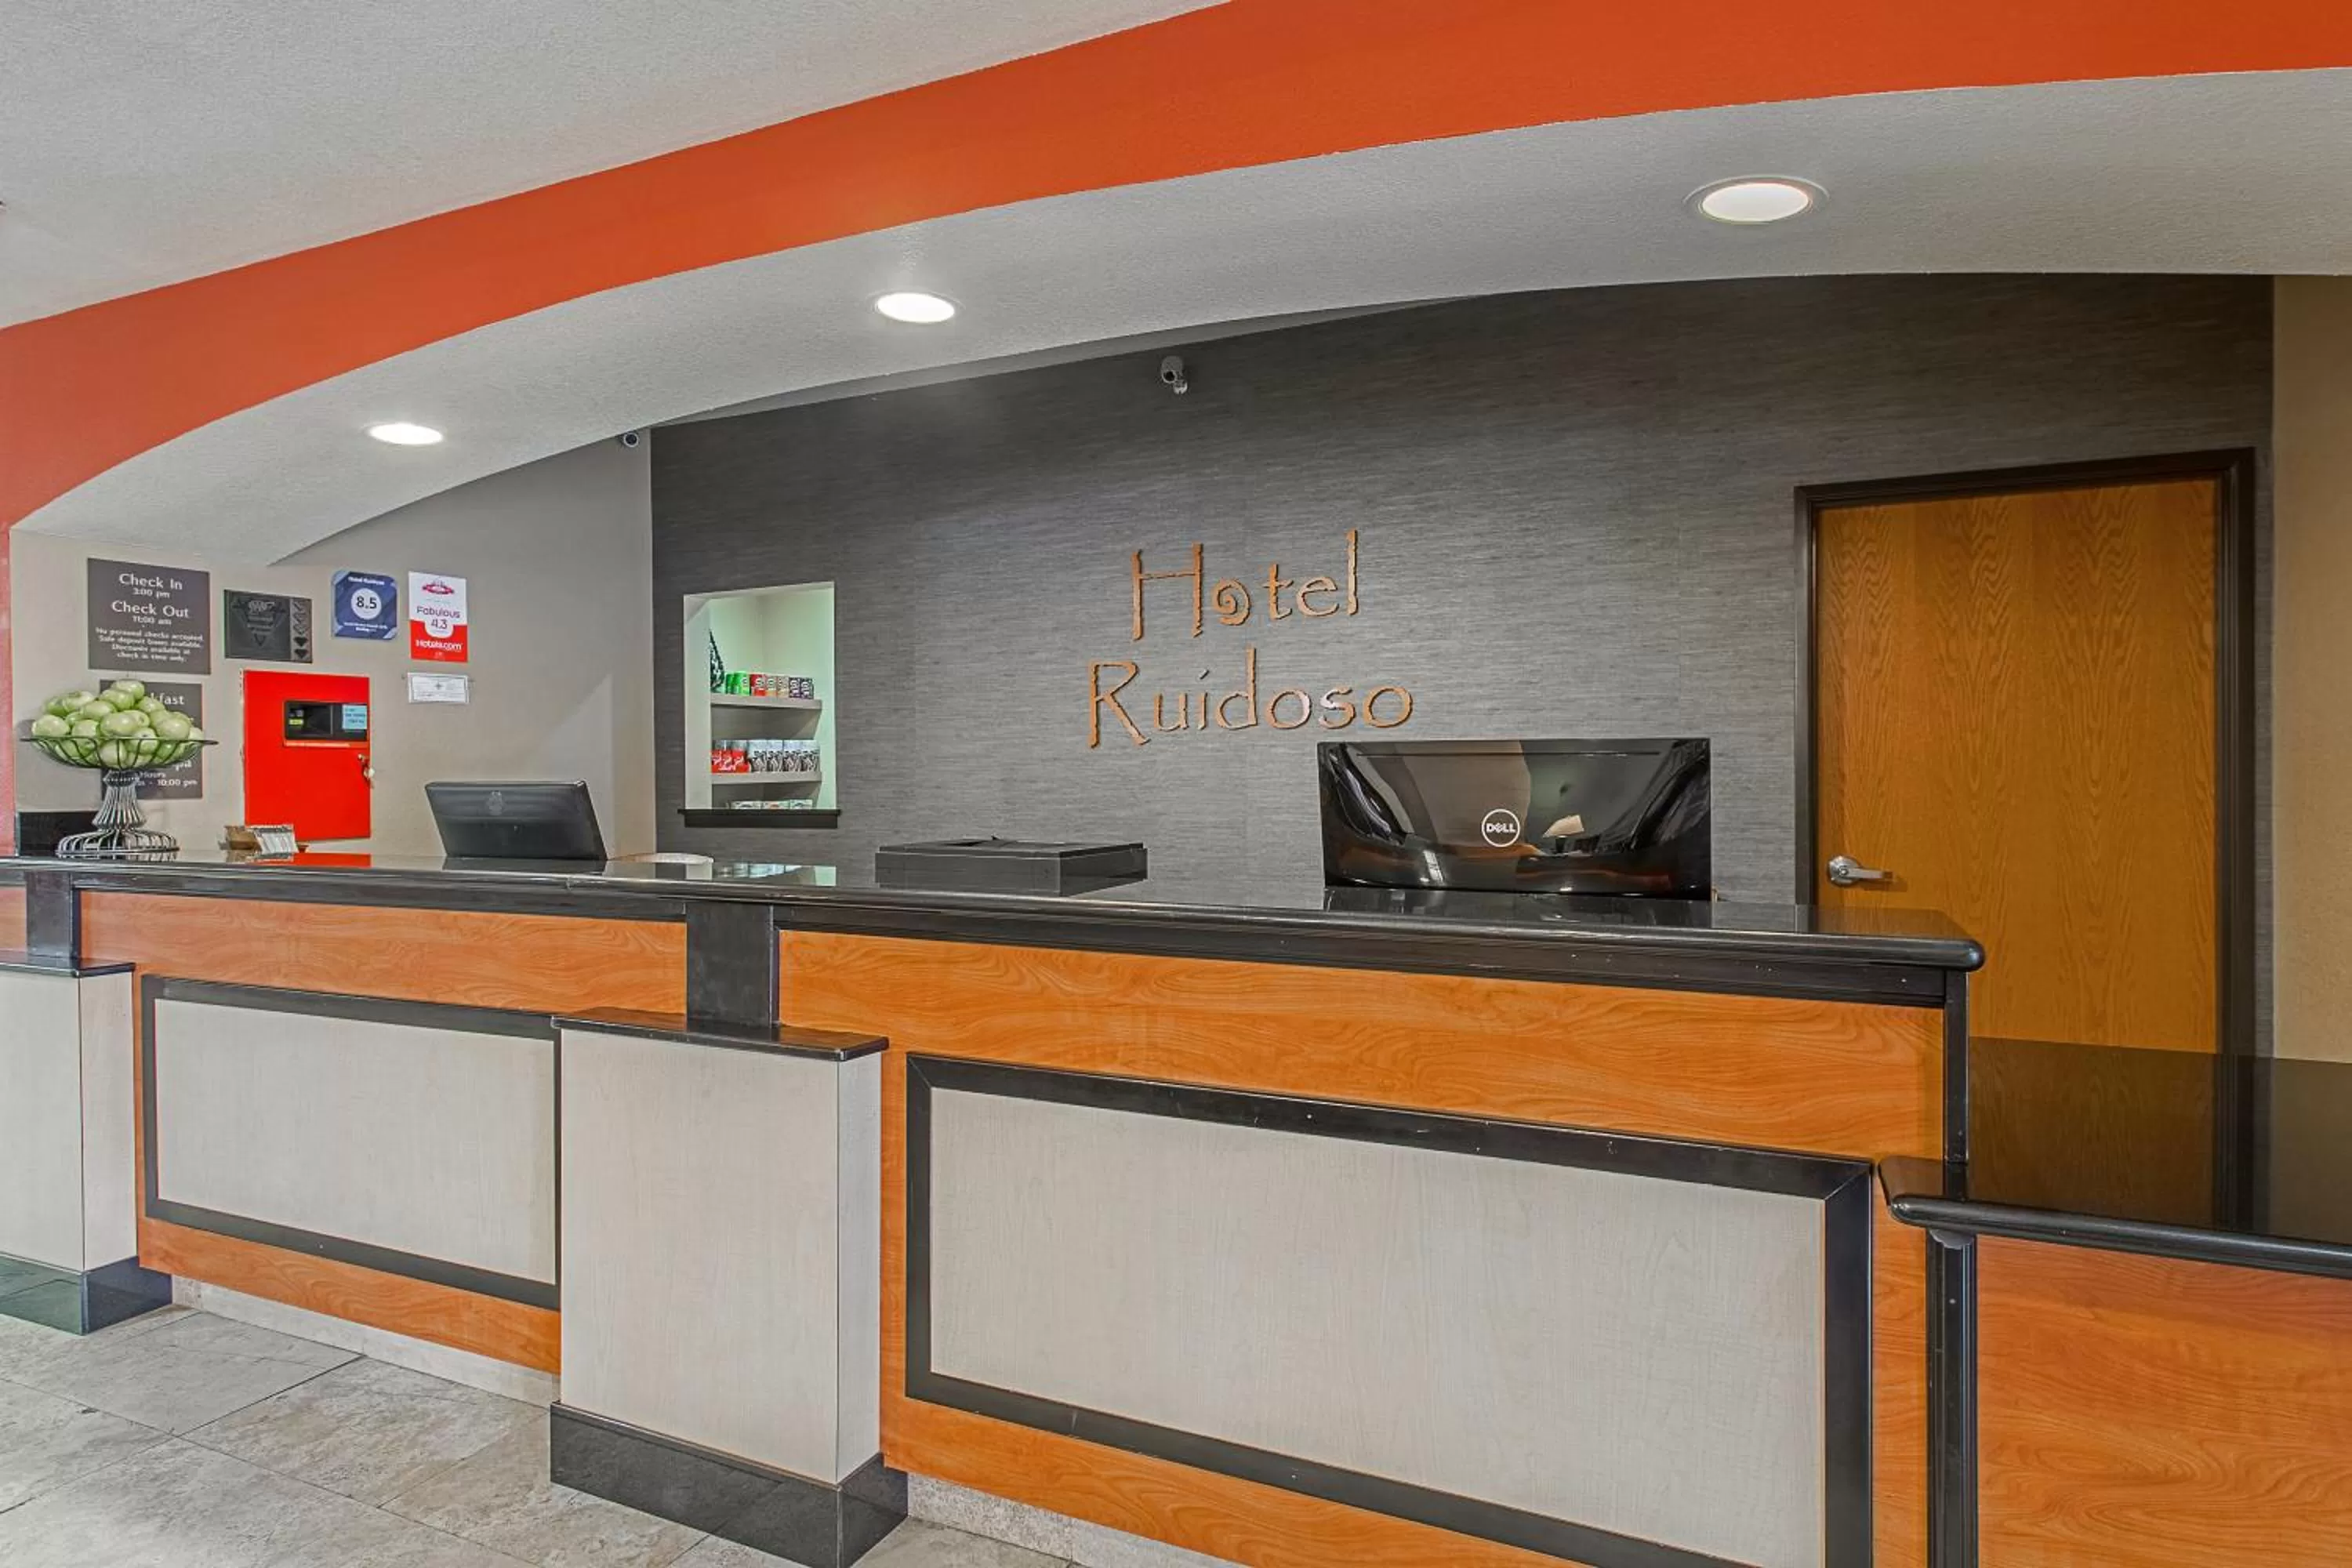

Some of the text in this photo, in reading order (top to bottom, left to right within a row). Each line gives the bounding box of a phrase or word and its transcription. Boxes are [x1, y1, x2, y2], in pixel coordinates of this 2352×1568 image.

[118, 572, 183, 590] Check In
[1131, 528, 1358, 641] Hotel
[132, 587, 170, 599] 3:00 pm
[111, 599, 189, 618] Check Out
[356, 595, 377, 609] 8.5
[416, 605, 461, 619] Fabulous
[1090, 645, 1414, 749] Ruidoso
[183, 779, 198, 788] pm
[1486, 822, 1516, 834] DELL
